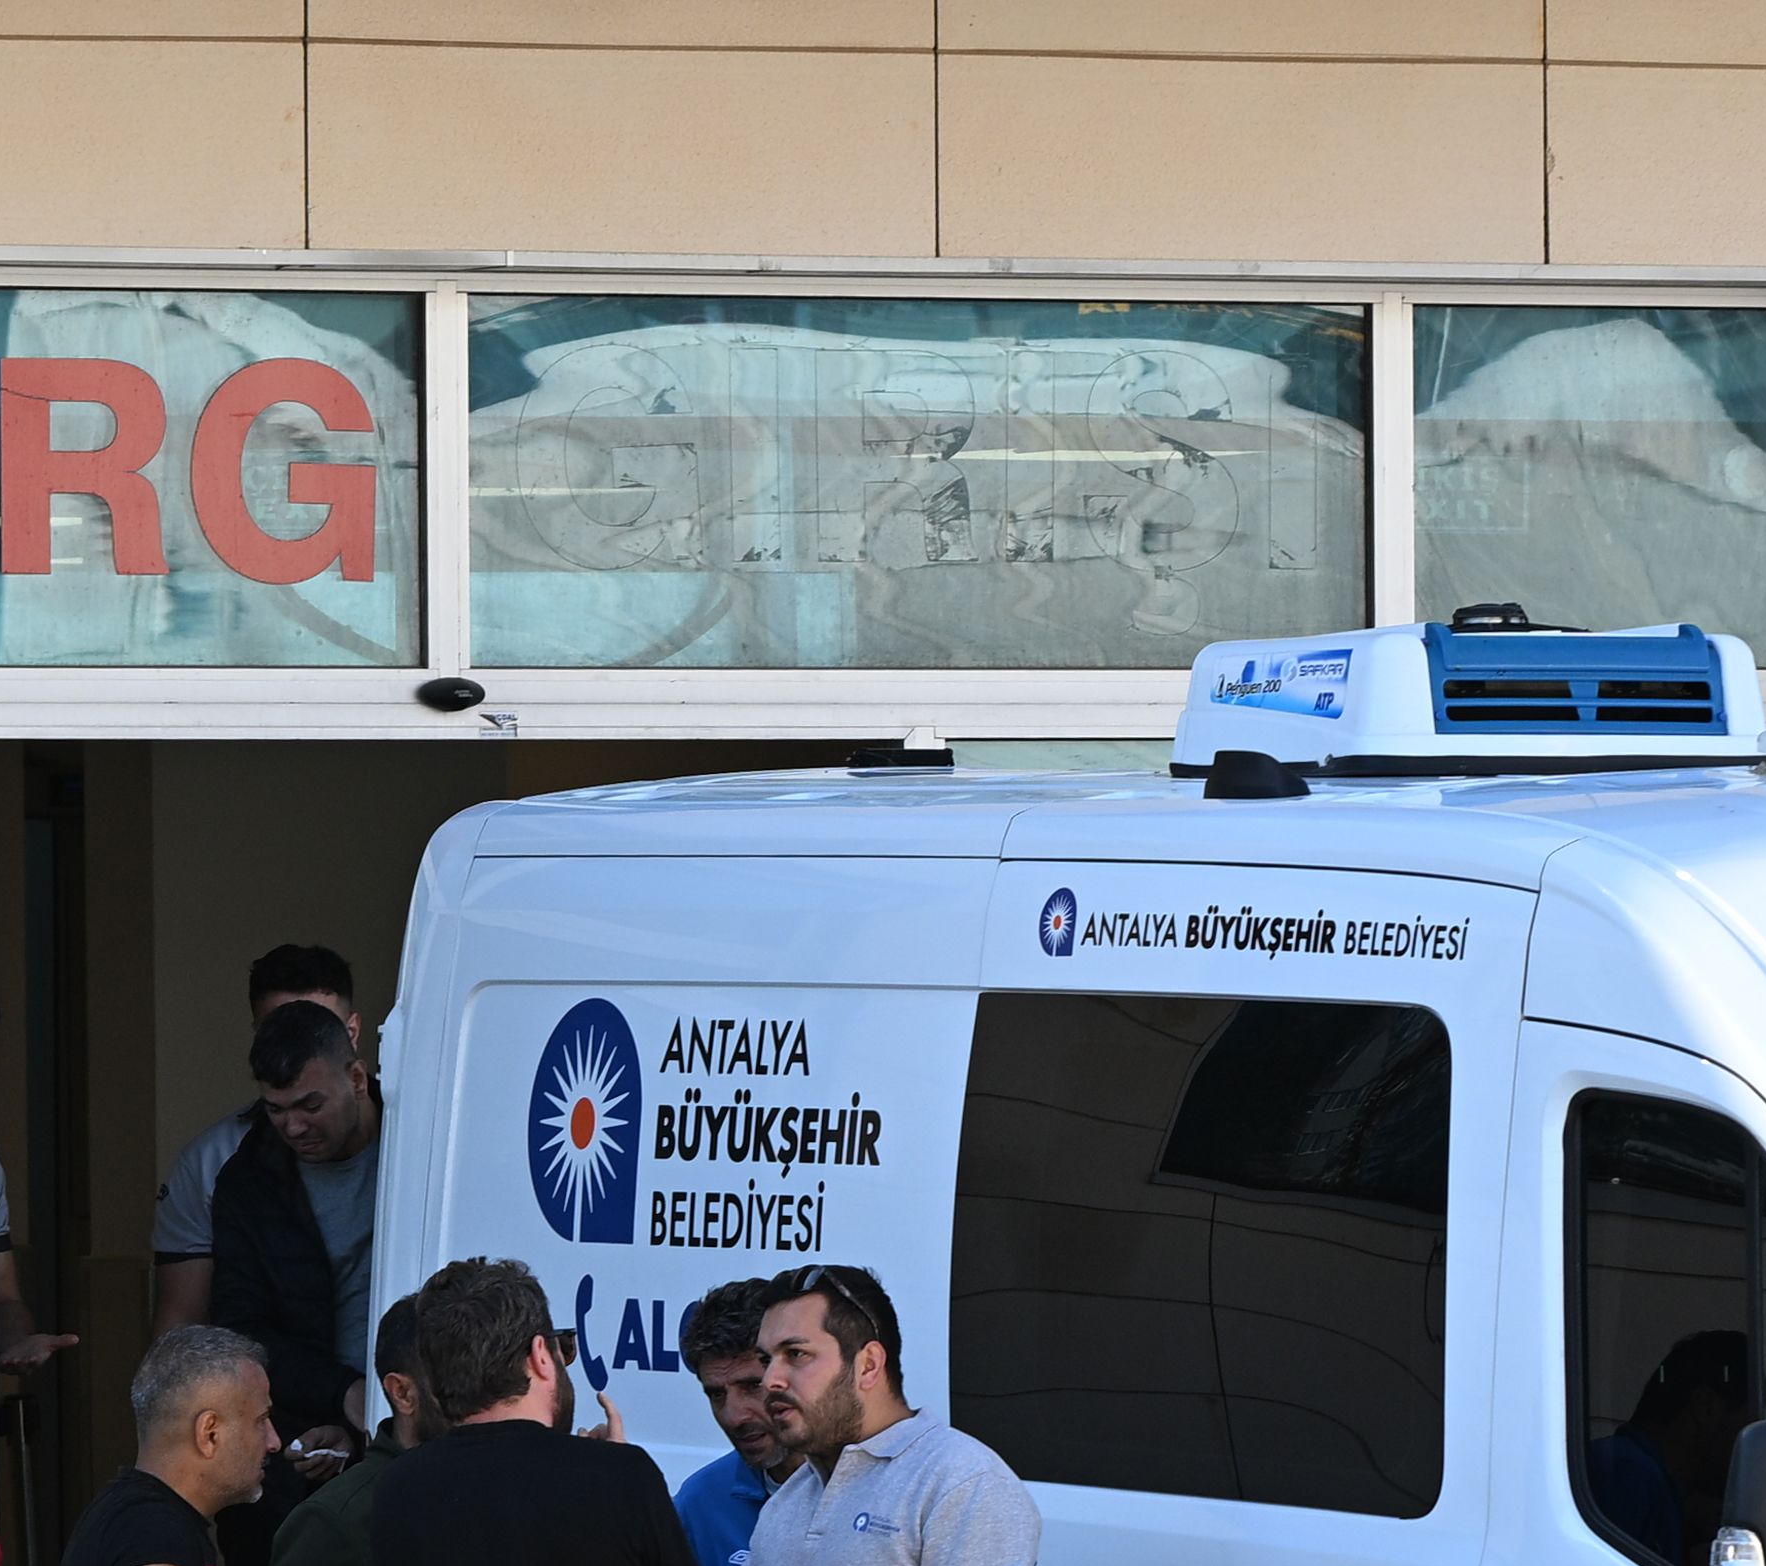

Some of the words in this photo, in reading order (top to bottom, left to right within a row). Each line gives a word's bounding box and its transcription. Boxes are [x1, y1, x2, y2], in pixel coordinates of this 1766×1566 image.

[1262, 679, 1282, 693] 200
[1299, 662, 1345, 677] SAFKAR
[1314, 692, 1335, 711] ATP
[1080, 911, 1178, 948] ANTALYA
[1184, 905, 1335, 960] BÜYÜKŞEHİR
[1343, 915, 1470, 960] BELEDİYESİ
[659, 1016, 810, 1077] ANTALYA
[654, 1087, 882, 1179] BÜYÜKŞEHİR
[649, 1178, 825, 1252] BELEDİYESİ
[612, 1297, 699, 1375] AL
